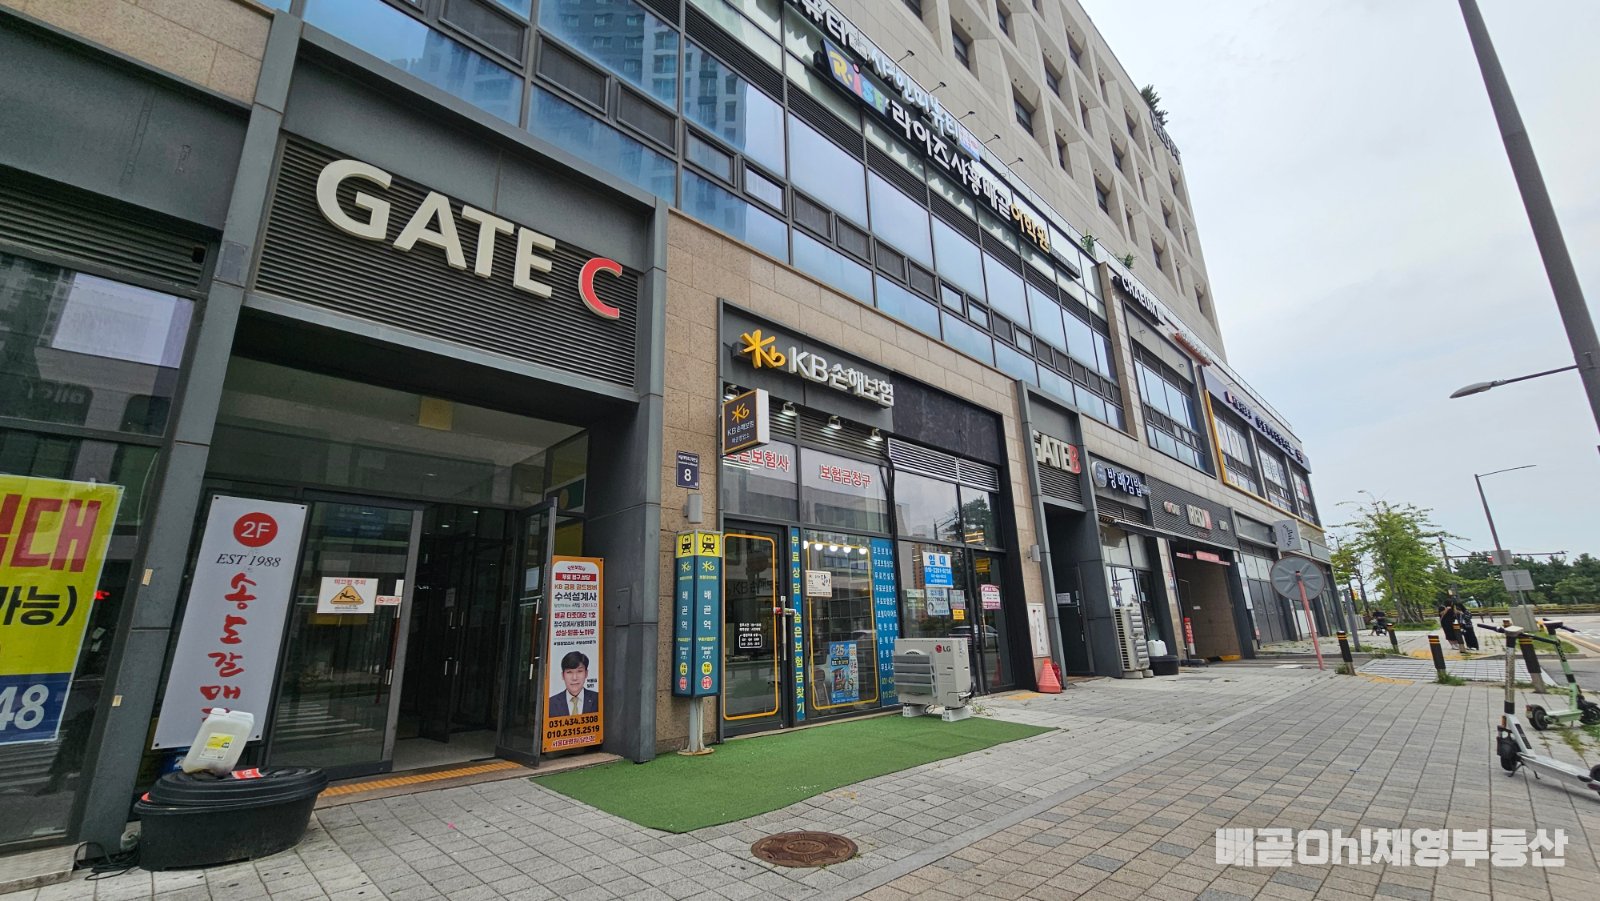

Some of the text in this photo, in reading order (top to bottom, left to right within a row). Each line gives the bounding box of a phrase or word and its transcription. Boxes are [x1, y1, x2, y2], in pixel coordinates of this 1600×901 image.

[316, 159, 623, 319] GATE C
[788, 346, 894, 409] KB손해보험
[727, 449, 790, 473] 든보험사
[1069, 444, 1082, 475] B
[684, 468, 692, 482] 8
[819, 465, 872, 488] 보험금청구
[242, 519, 270, 539] 2F
[216, 553, 282, 569] EST 1988
[554, 592, 598, 601] 수석설계사
[200, 572, 257, 723] 송도갈매
[546, 724, 600, 739] 010.2315.2519
